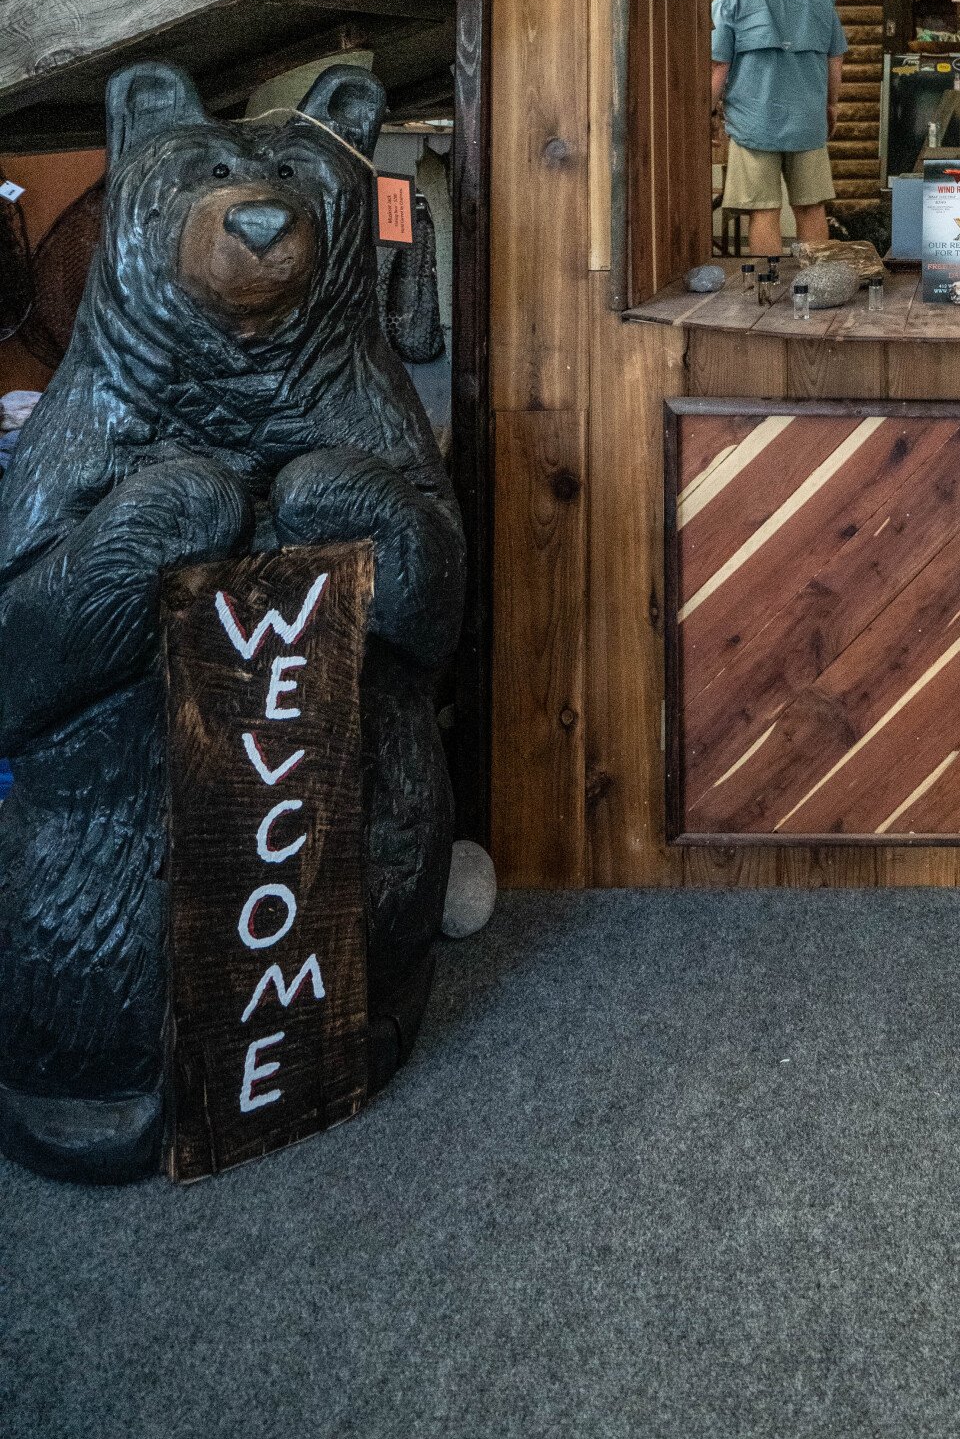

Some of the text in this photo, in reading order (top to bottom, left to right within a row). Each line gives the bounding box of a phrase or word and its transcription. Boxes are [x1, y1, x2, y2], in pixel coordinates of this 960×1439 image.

[938, 185, 955, 194] WIND
[928, 241, 948, 249] OUR
[935, 249, 953, 257] FOR
[215, 572, 329, 1113] WELCOME
